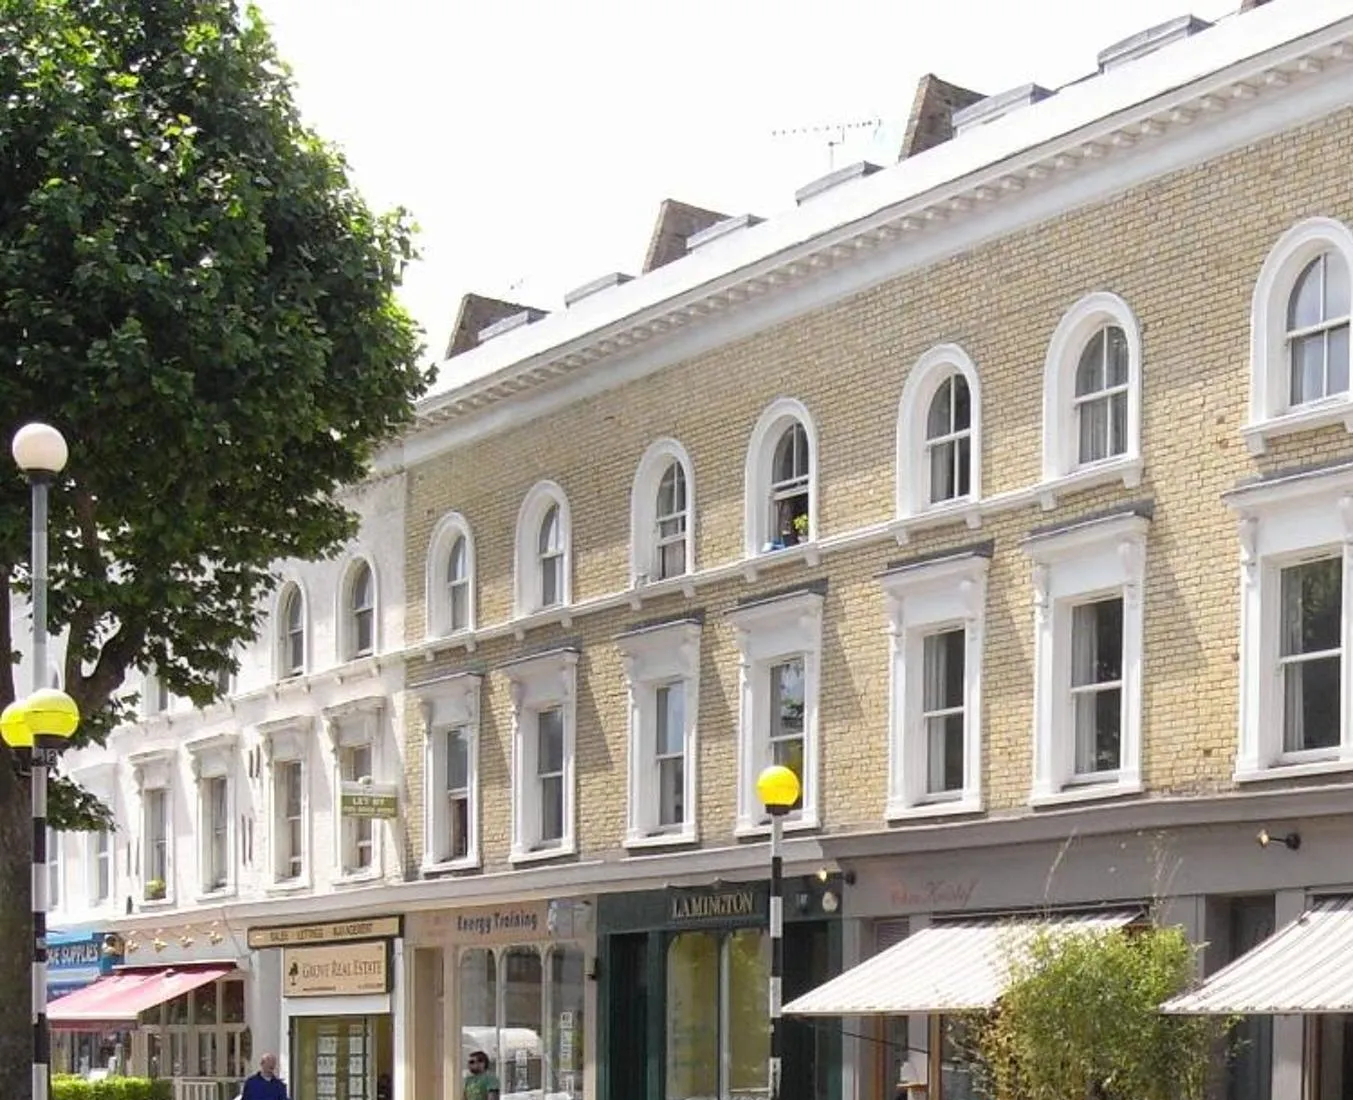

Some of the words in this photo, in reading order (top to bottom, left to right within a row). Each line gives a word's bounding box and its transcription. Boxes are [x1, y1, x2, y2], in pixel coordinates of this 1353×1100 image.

[672, 890, 754, 918] LAMINGTON
[457, 914, 491, 934] Energy
[494, 910, 538, 931] Training
[331, 958, 350, 977] REAL
[353, 958, 382, 976] ESTATE
